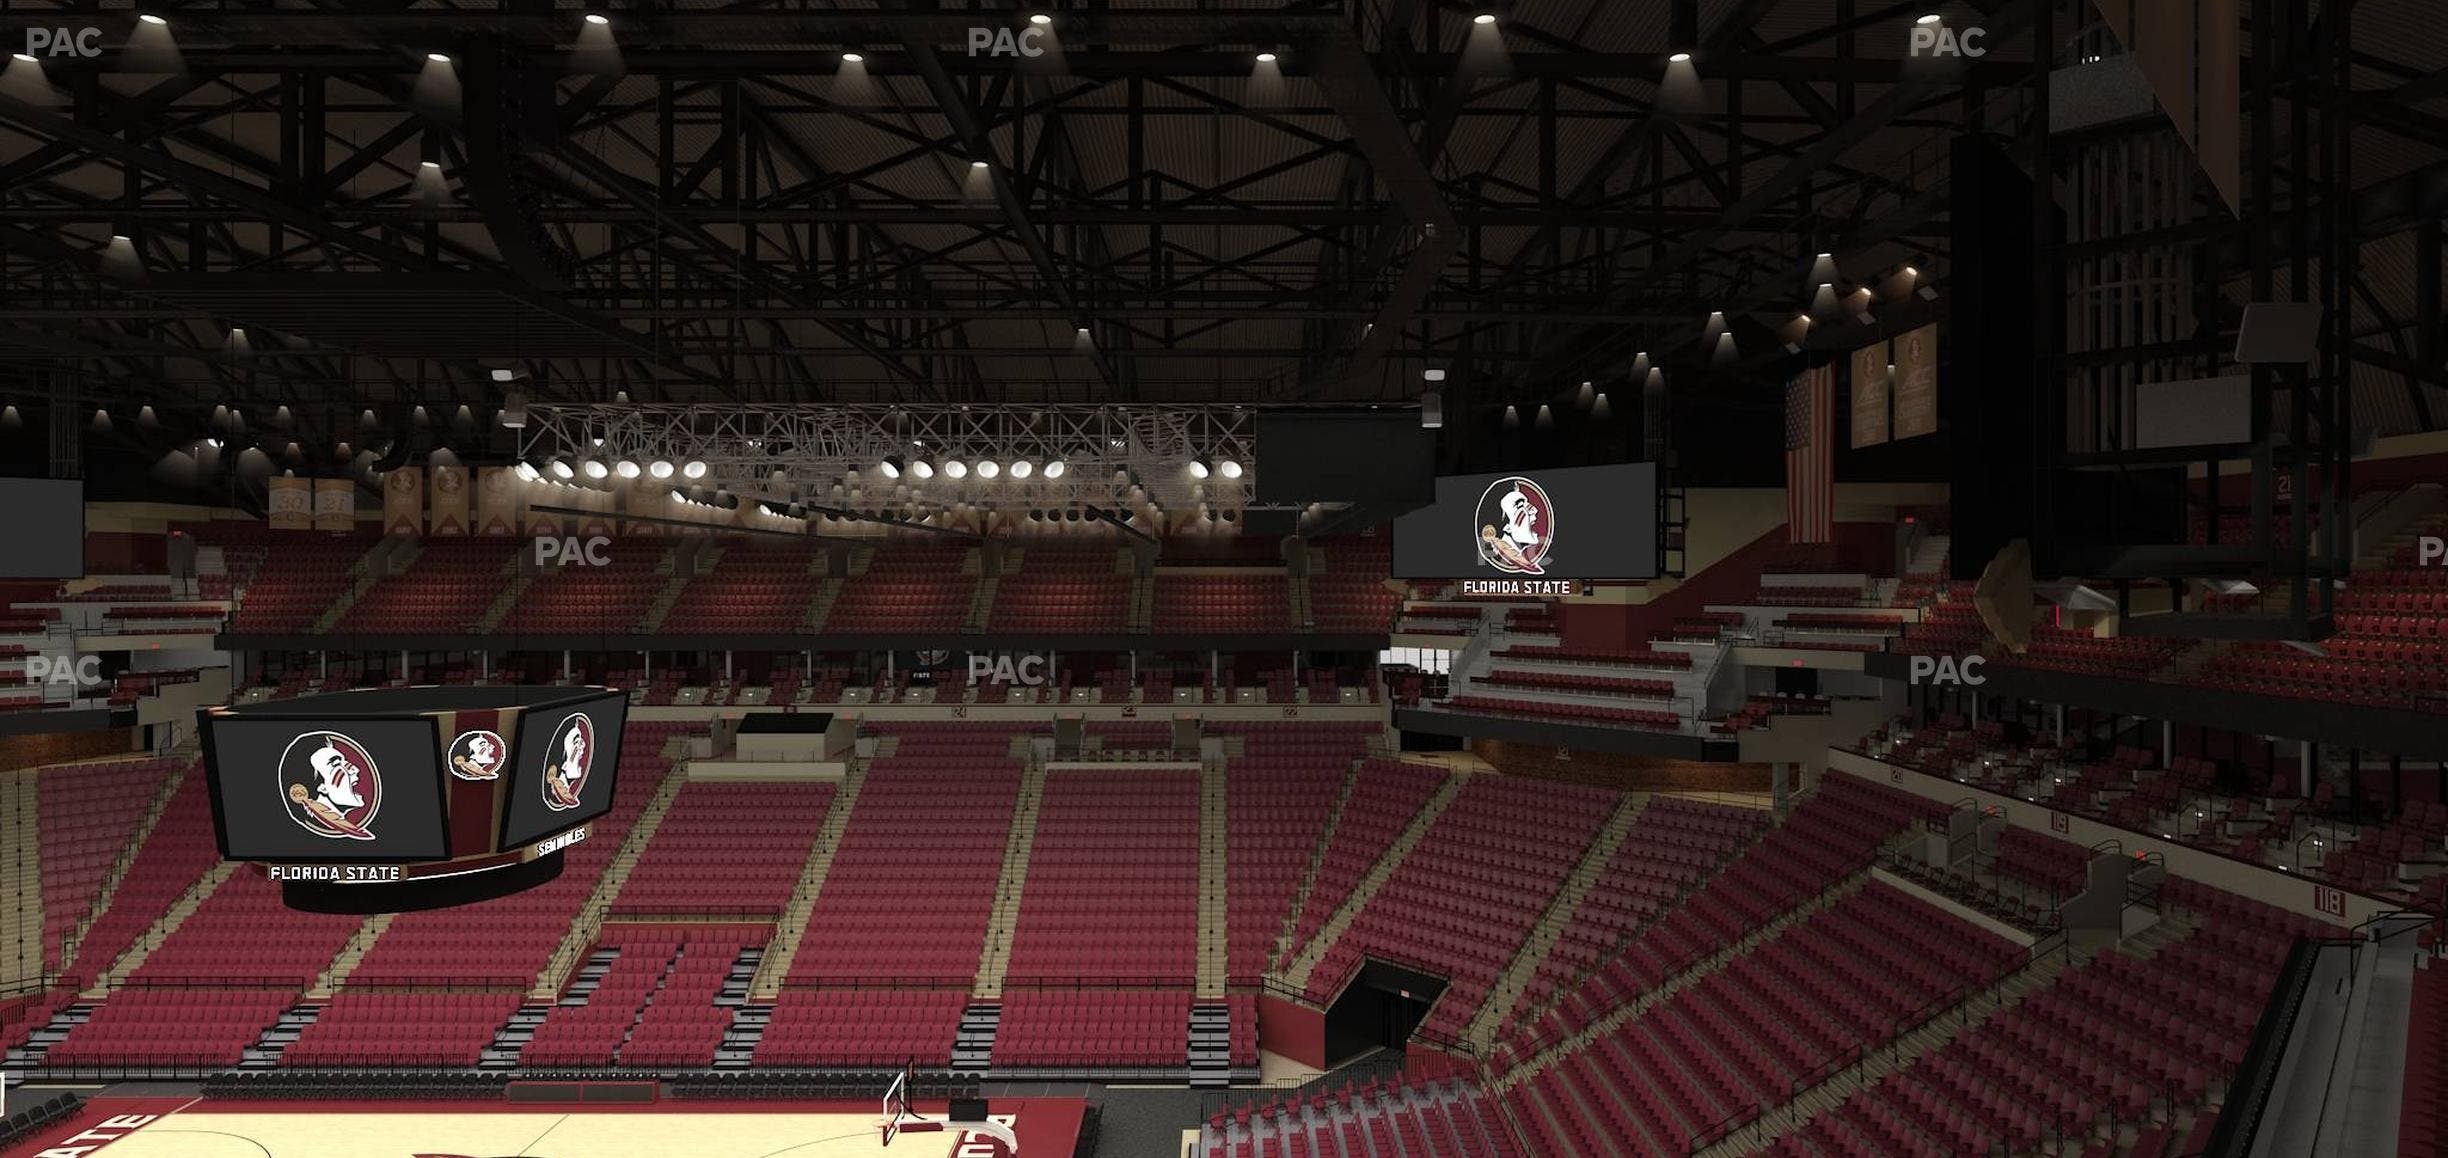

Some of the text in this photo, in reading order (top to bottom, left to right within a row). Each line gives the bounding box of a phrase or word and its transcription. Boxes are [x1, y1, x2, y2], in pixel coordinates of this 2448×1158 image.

[1463, 580, 1571, 594] FLORIDA STATE
[270, 866, 400, 880] FLORIDA STATE
